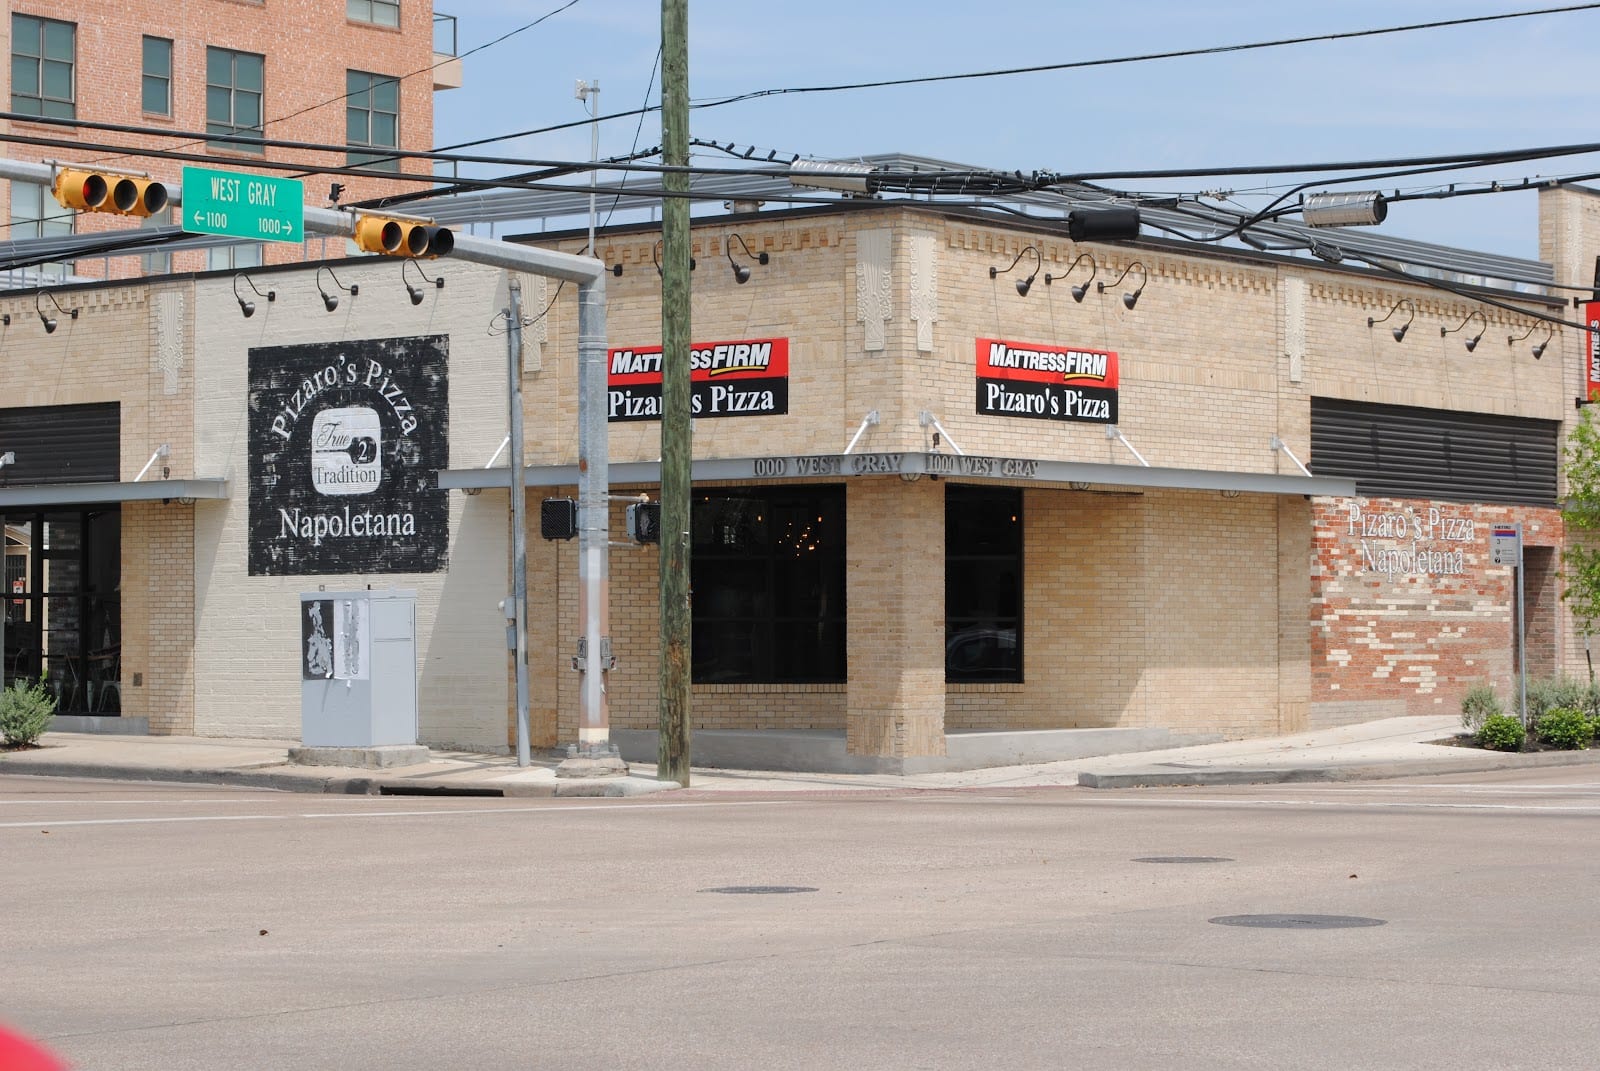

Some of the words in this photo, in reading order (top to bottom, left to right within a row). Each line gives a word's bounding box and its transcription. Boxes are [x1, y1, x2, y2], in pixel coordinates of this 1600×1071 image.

[211, 177, 240, 202] WEST
[248, 181, 276, 207] GRAY
[206, 211, 227, 228] 1100
[259, 217, 280, 234] 1000
[611, 342, 772, 375] MATTSSFIRM
[1590, 319, 1600, 382] MATTRES
[271, 354, 357, 442] Pizaro's
[363, 359, 418, 437] Pizza
[608, 390, 703, 417] Pizas
[709, 384, 775, 413] Pizza
[985, 382, 1060, 415] Pizaro's
[1063, 389, 1110, 419] Pizza
[316, 421, 350, 448] True
[358, 441, 368, 461] 2
[752, 458, 786, 476] 1000
[795, 456, 841, 475] WEST
[852, 454, 902, 473] GRAY
[927, 455, 956, 473] 1000
[959, 456, 998, 476] WEST
[1002, 459, 1040, 478] GRAY
[314, 465, 377, 485] Tradition
[279, 506, 417, 547] Napoletana
[1347, 502, 1423, 540] Pizaro's
[1428, 506, 1475, 541] Pizza
[1360, 538, 1464, 583] Napoletana
